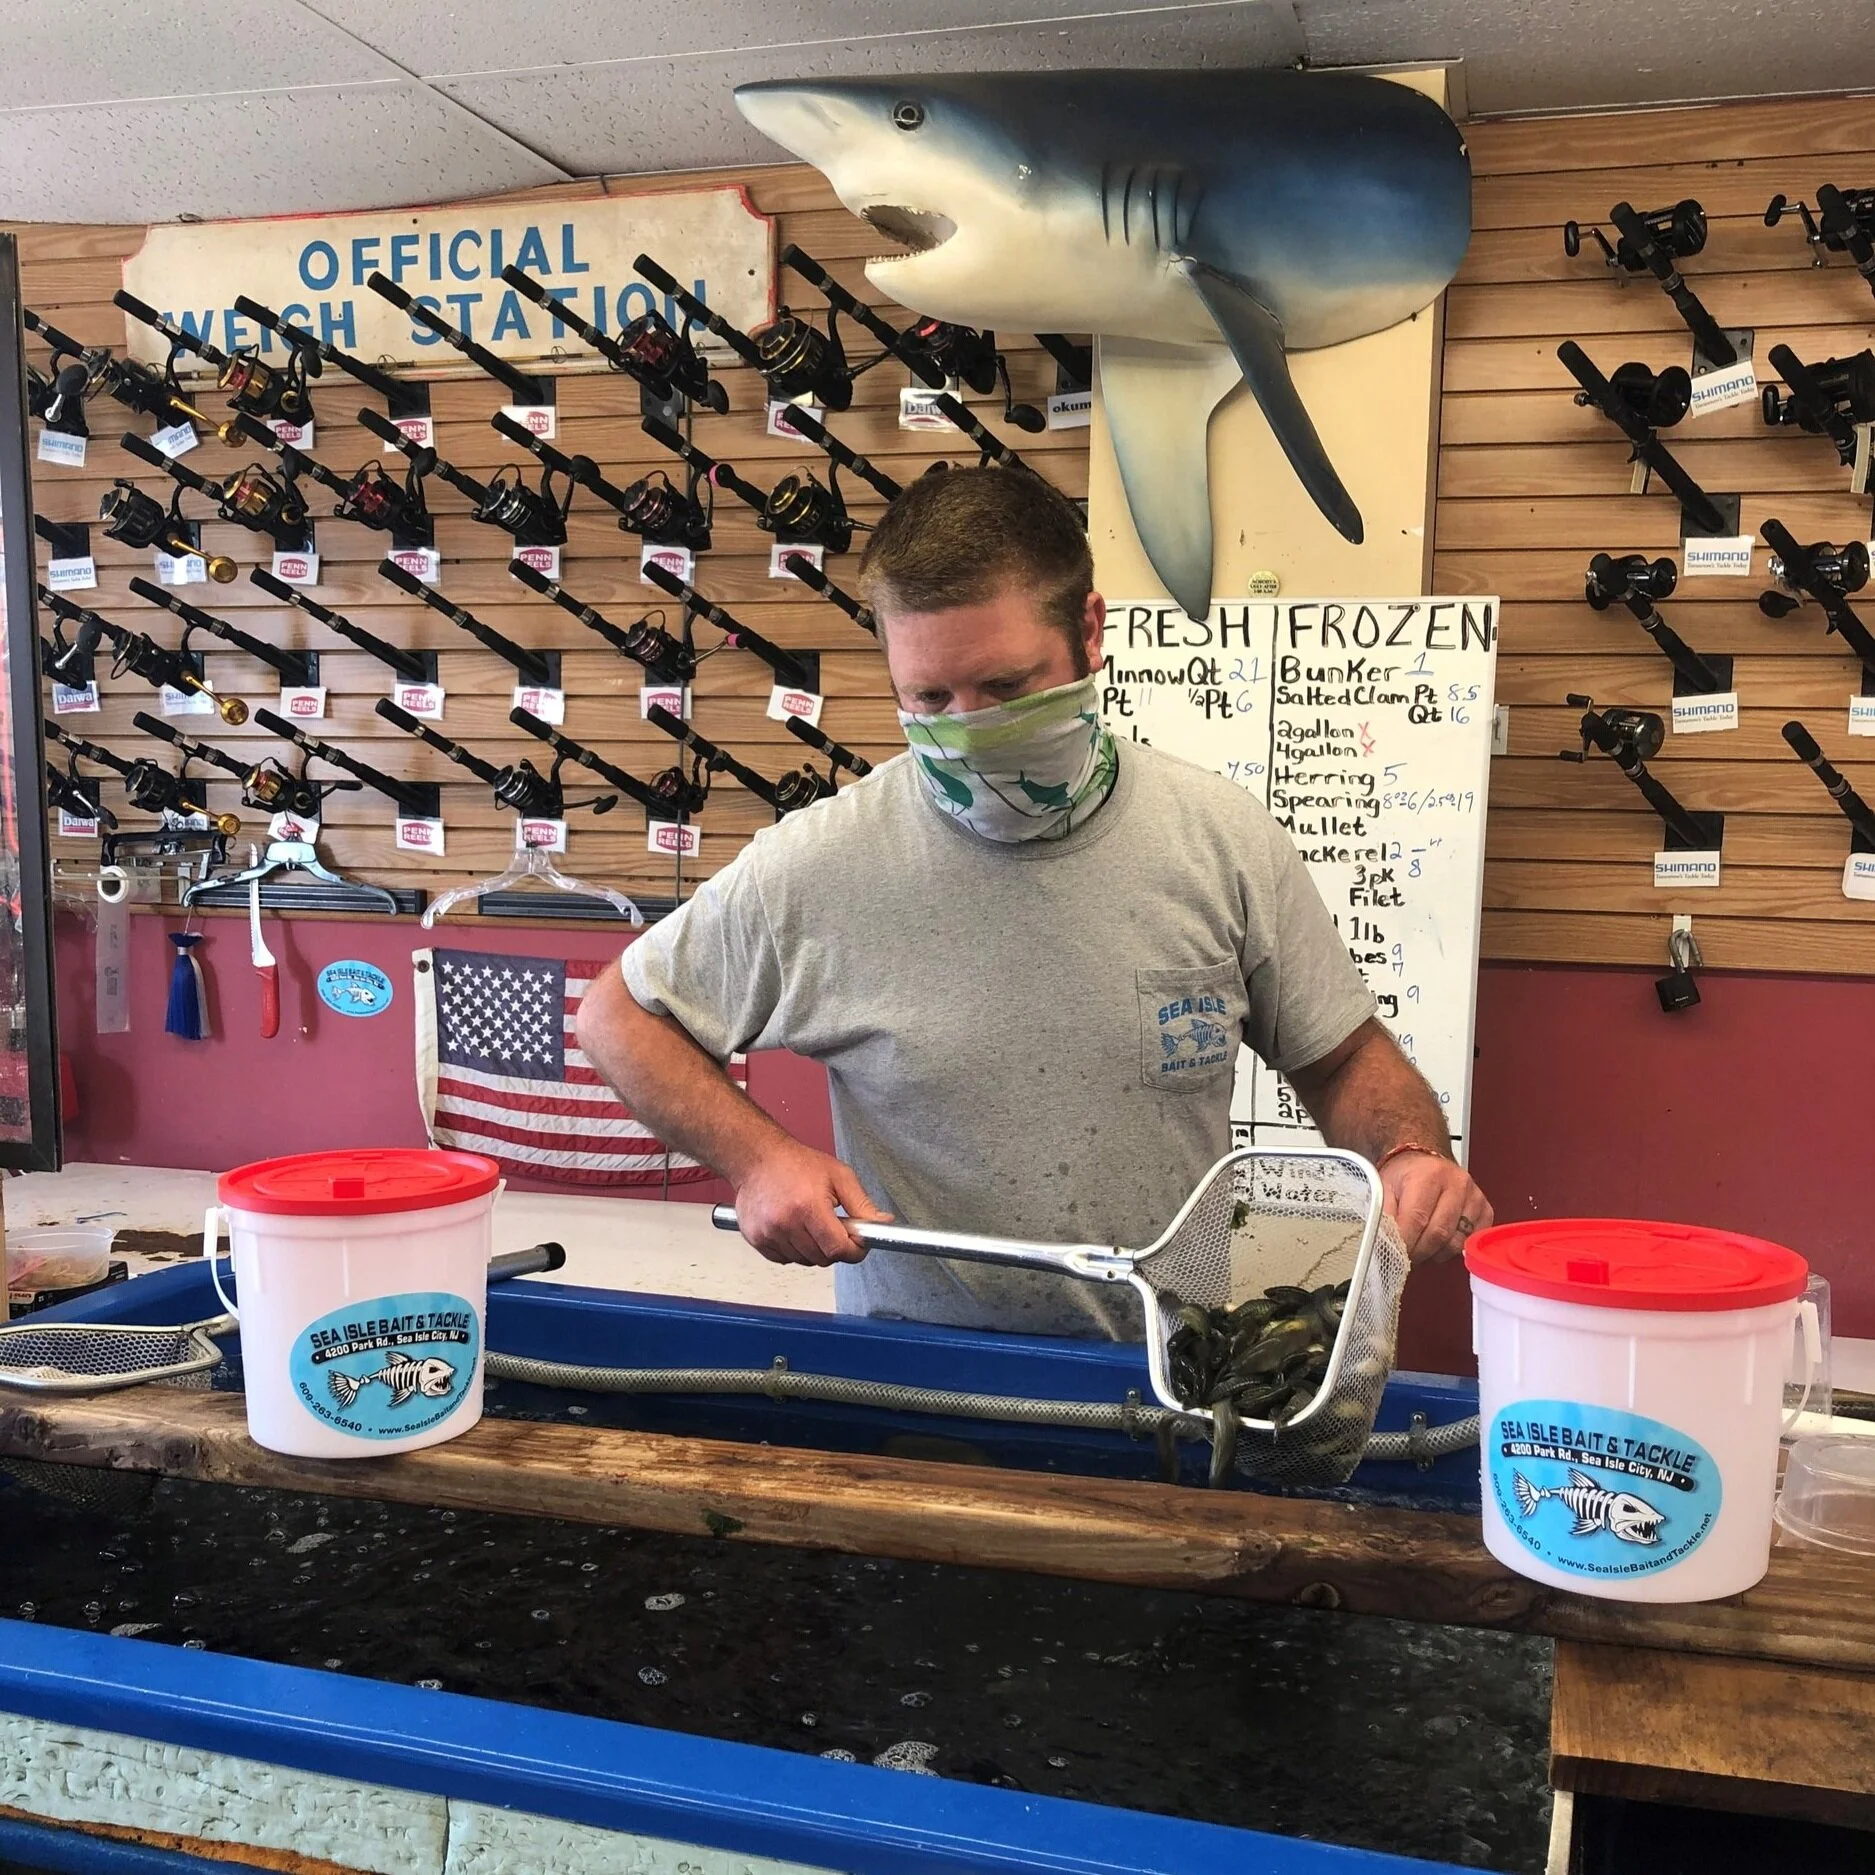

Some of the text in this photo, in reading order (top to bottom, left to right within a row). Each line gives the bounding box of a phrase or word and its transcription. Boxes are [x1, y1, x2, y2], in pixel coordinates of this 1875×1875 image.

[298, 223, 589, 291] OFFICIAL
[164, 300, 357, 358] WEIGH
[1692, 375, 1754, 402] SHIMANO
[906, 401, 944, 416] Daiw
[1052, 401, 1091, 413] okum
[525, 413, 549, 424] ENN
[400, 424, 426, 434] ENN
[280, 561, 308, 570] PENN
[395, 556, 428, 566] PENN
[520, 553, 552, 562] PENN
[1687, 551, 1749, 561] SHIMANO
[50, 566, 91, 579] SHIMANO
[280, 568, 308, 577] REELS
[1101, 605, 1251, 649] FRESH
[1289, 603, 1493, 652] FROZEN
[293, 699, 318, 708] PENN
[403, 698, 436, 710] REELS
[785, 695, 814, 707] PENN
[1103, 686, 1134, 717] Pt
[1236, 689, 1253, 712] 6
[1414, 683, 1439, 705] Pt
[291, 706, 317, 714] REELS
[783, 701, 812, 714] REELS
[1408, 704, 1470, 725] Qt 16
[1673, 703, 1735, 717] SHIMANO
[1274, 762, 1408, 797] Herring 5
[1272, 789, 1381, 818] Spearing
[524, 826, 558, 836] PENN
[1275, 815, 1367, 837] Mullet
[403, 834, 430, 842] REEL
[658, 837, 692, 849] REELS
[1408, 858, 1422, 878] 8
[1655, 862, 1717, 873] SHIMANO
[1350, 886, 1406, 907] Filet
[1407, 984, 1420, 1004] 9
[1158, 995, 1227, 1026] SEA ISLE
[1161, 1050, 1228, 1073] BAIT & TACKLE
[309, 1312, 471, 1349] SEA ISLE BAIT & TACKLE
[324, 1344, 350, 1359] 4200
[352, 1339, 375, 1353] Park
[396, 1333, 413, 1345] Sea
[414, 1331, 430, 1342] Isle
[431, 1330, 448, 1343] City,
[448, 1330, 460, 1341] NJ
[299, 1381, 363, 1432] 609-263-6540
[1500, 1421, 1697, 1473] SEA ISLE BAIT & TACKLE
[1510, 1443, 1675, 1482] 4200 Park Rd., Sea Isle City, NJ
